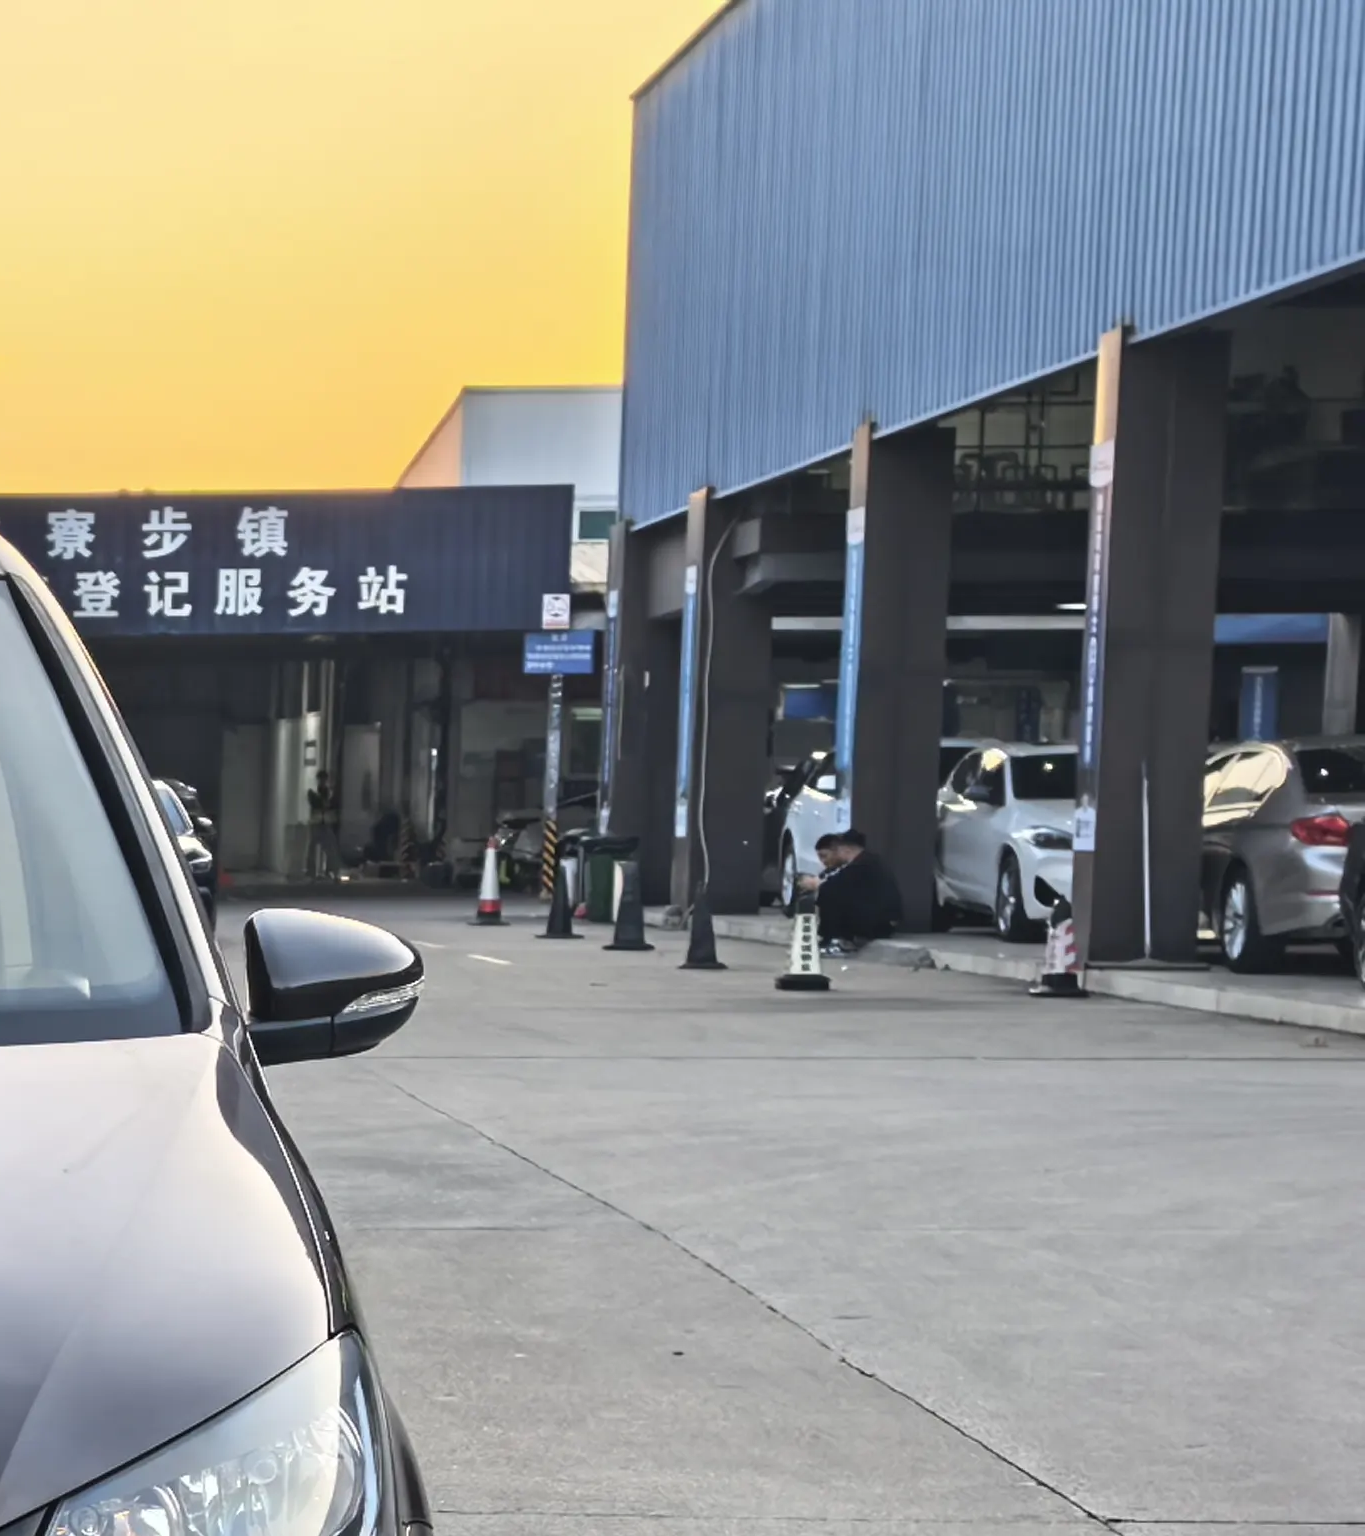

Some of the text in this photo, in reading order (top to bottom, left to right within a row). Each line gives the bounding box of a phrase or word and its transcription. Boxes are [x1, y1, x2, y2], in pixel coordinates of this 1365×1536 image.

[43, 565, 408, 618] 登记服务站
